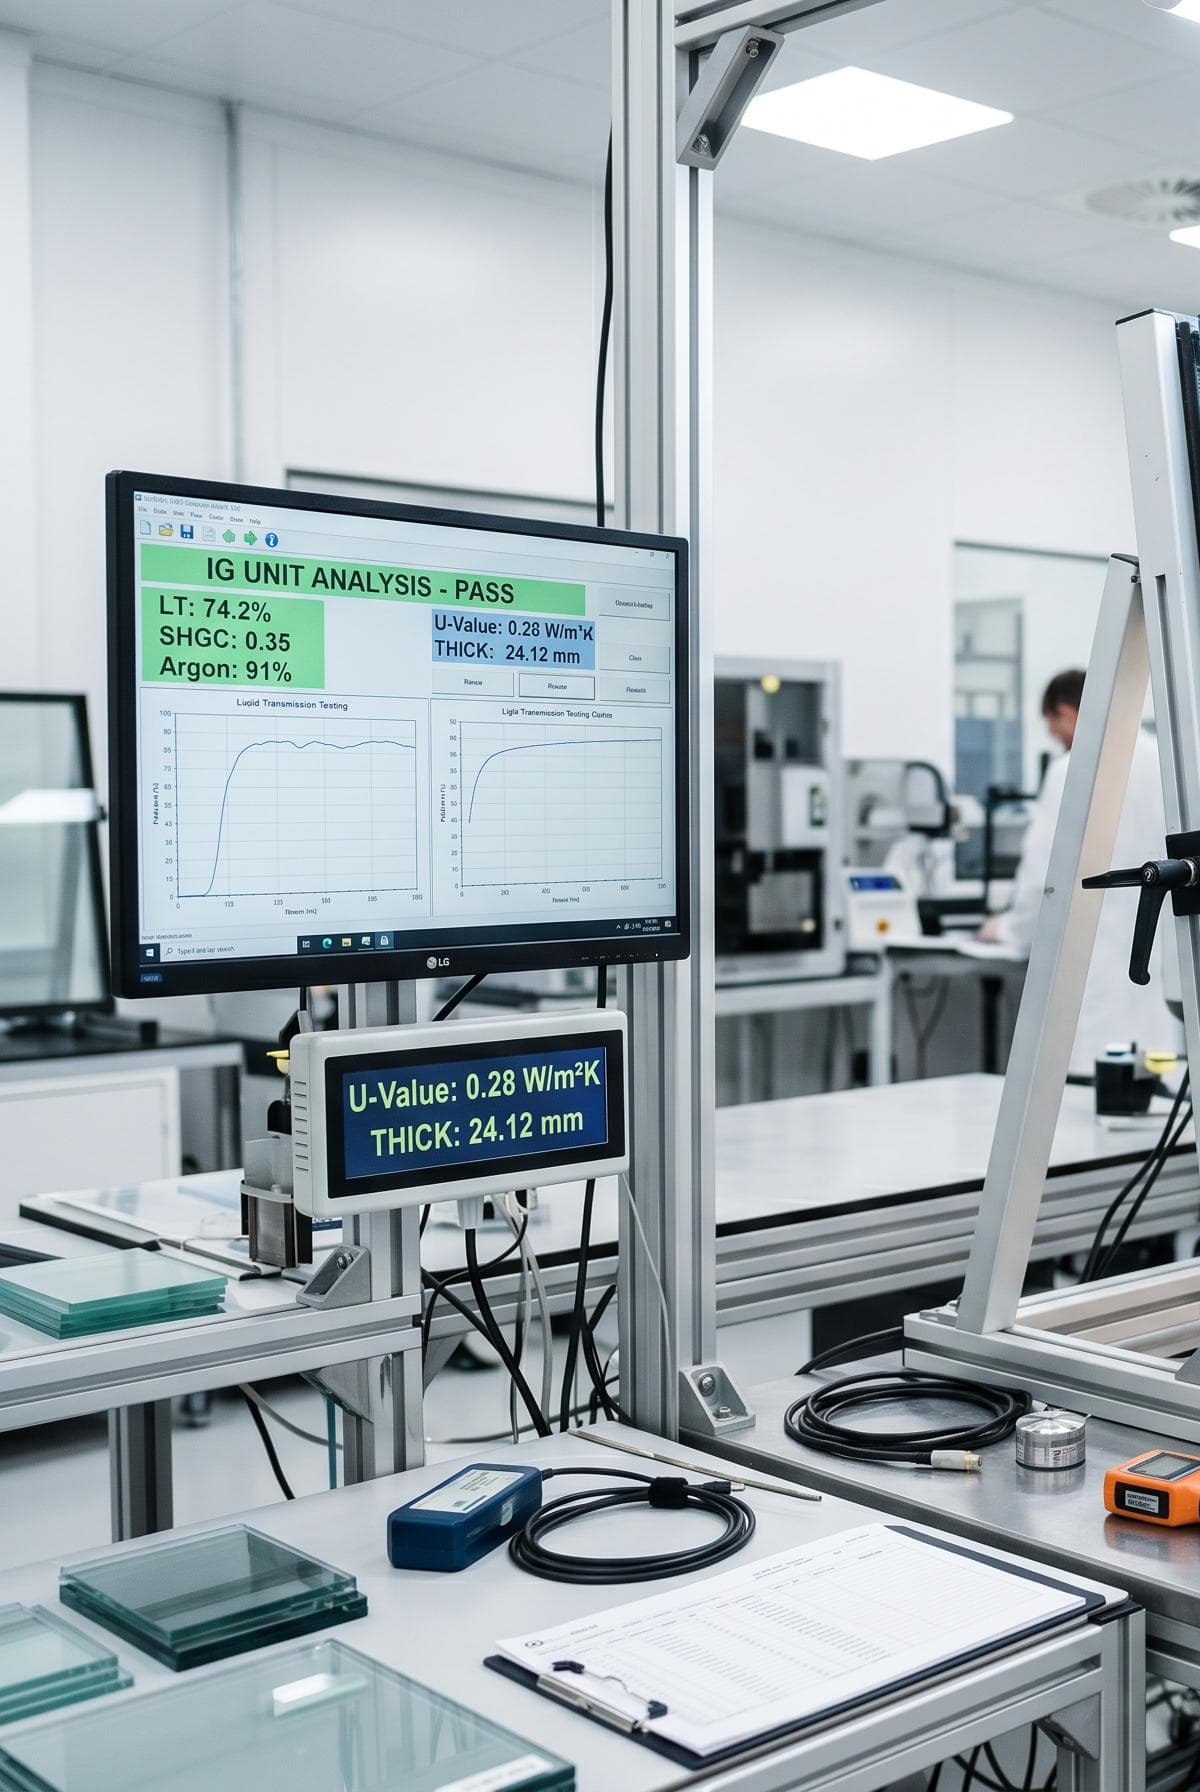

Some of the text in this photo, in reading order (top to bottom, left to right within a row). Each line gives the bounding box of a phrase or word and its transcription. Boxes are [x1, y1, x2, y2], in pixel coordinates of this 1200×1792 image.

[207, 557, 235, 581] IG
[244, 560, 305, 587] UNIT
[311, 567, 432, 598] ANALYSIS
[455, 579, 515, 604] PASS
[159, 595, 272, 623] LT: 74.2%
[159, 625, 291, 652] SHGC: 0.35
[434, 614, 502, 635] U-Value:
[508, 620, 541, 638] 0.28
[434, 640, 580, 664] THICK: 24.12 mm
[159, 656, 292, 682] Argon: 91%
[262, 698, 317, 709] Transmission
[319, 701, 348, 711] Testing
[438, 957, 450, 967] LG
[349, 1059, 601, 1113] U-Value: 0.28 W/m²K
[370, 1110, 584, 1157] THICK: 24.12 mm
